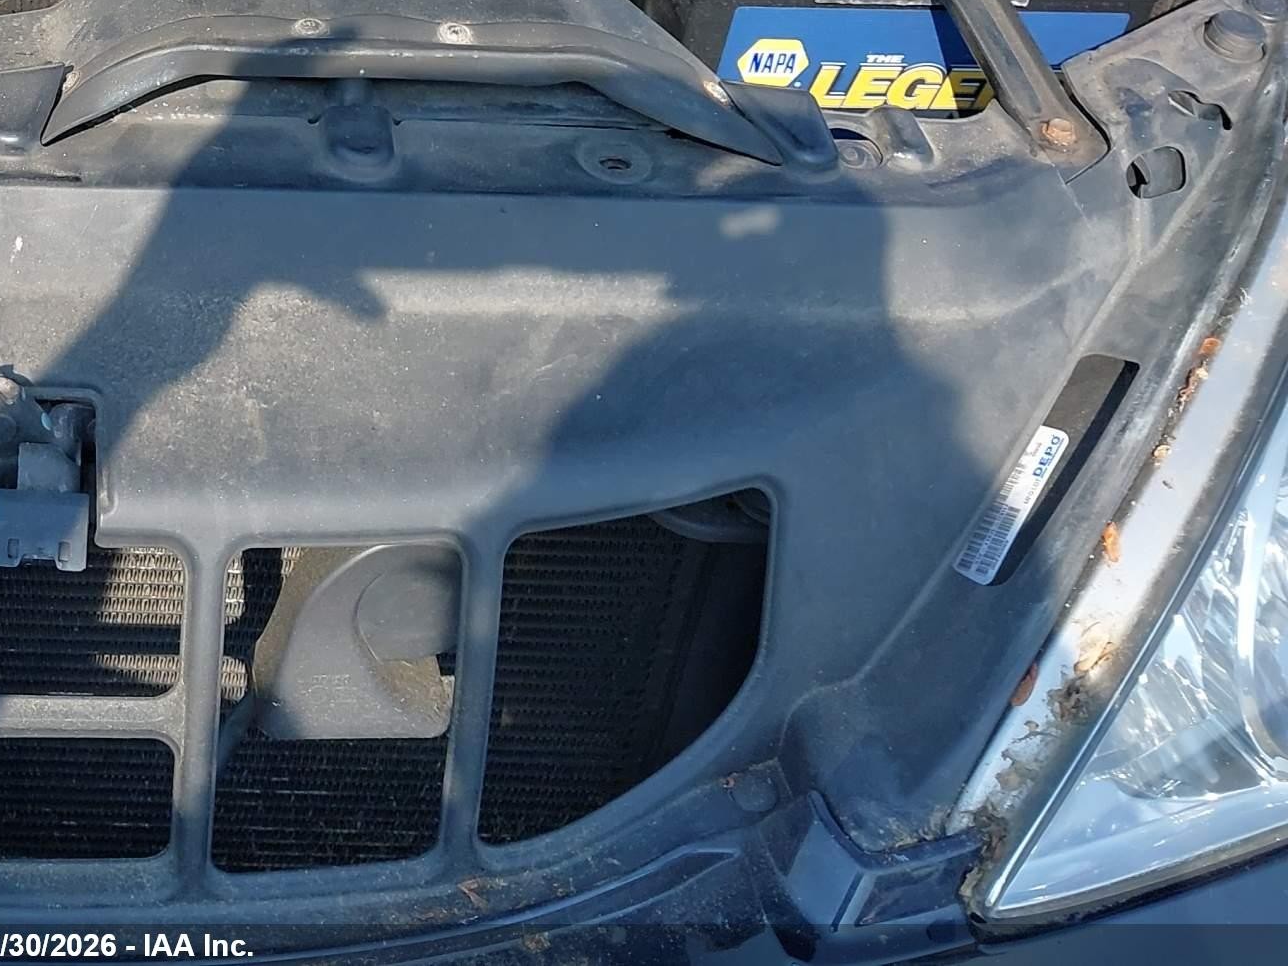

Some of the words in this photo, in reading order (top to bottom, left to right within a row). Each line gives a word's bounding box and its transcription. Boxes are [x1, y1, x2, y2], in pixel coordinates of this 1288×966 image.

[748, 52, 797, 74] NAPA
[866, 54, 906, 63] THE
[1032, 434, 1061, 477] DEPO
